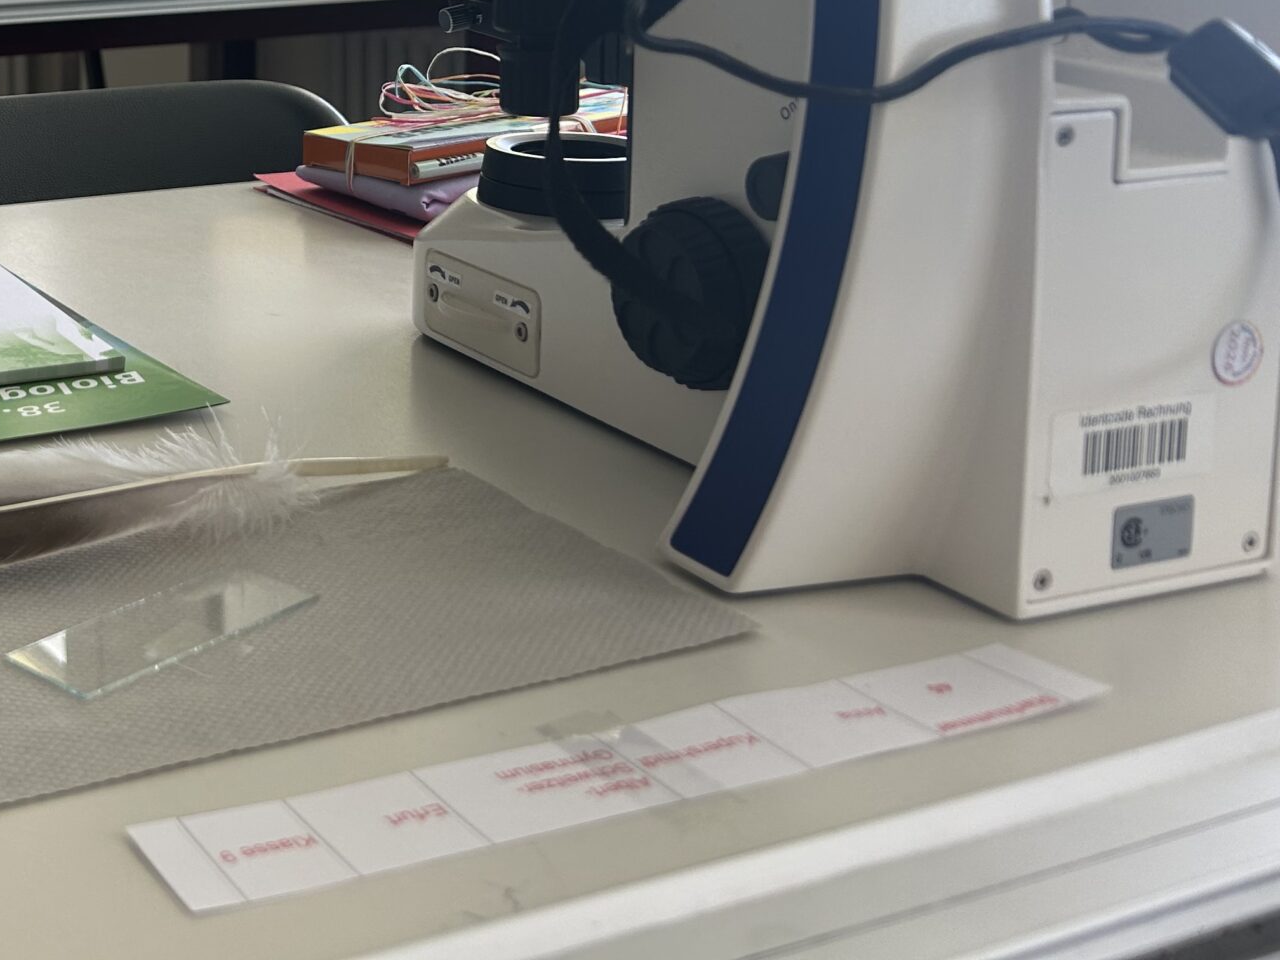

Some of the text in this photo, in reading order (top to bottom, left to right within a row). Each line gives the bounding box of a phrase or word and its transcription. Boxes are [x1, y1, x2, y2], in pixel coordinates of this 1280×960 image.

[1, 400, 67, 419] 38.
[387, 802, 450, 829] Erfurt
[239, 831, 319, 861] Klasse
